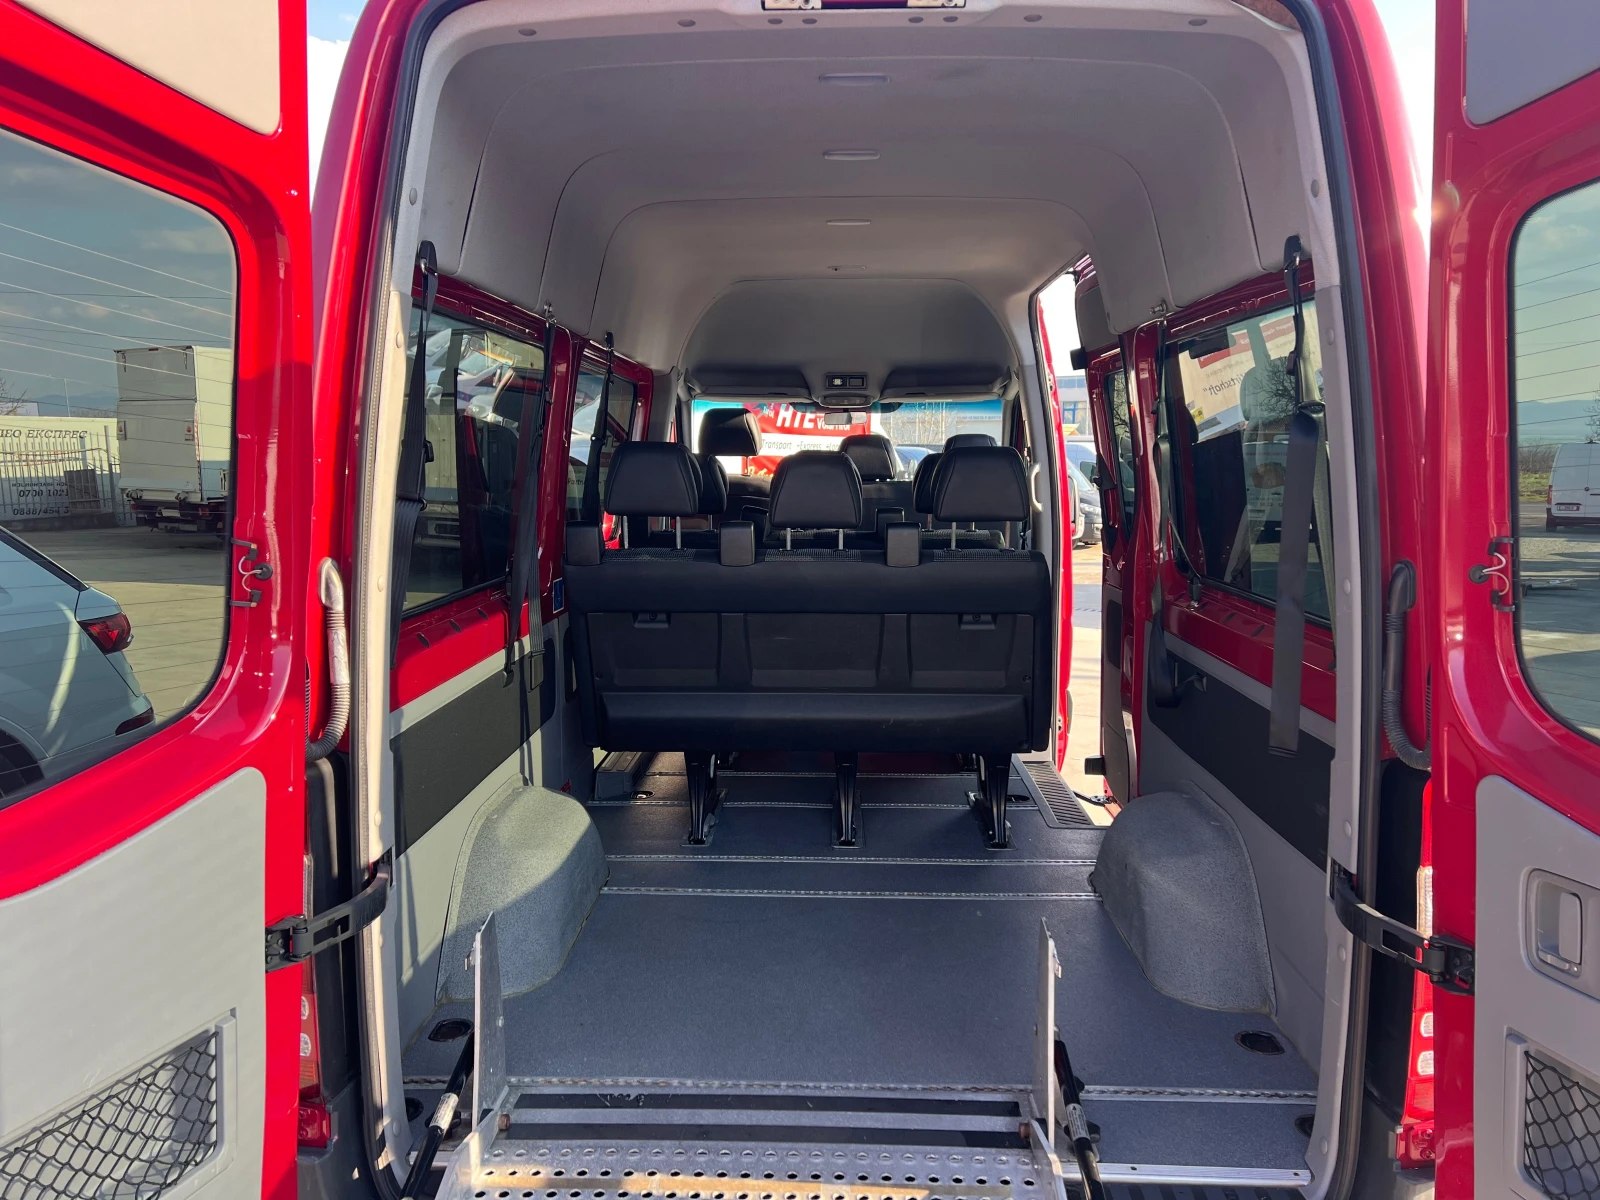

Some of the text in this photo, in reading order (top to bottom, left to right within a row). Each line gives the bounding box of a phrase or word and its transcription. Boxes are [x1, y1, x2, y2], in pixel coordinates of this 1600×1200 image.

[27, 429, 88, 439] ЕКСПРЕС
[762, 439, 792, 451] Transport
[19, 489, 43, 498] 0700
